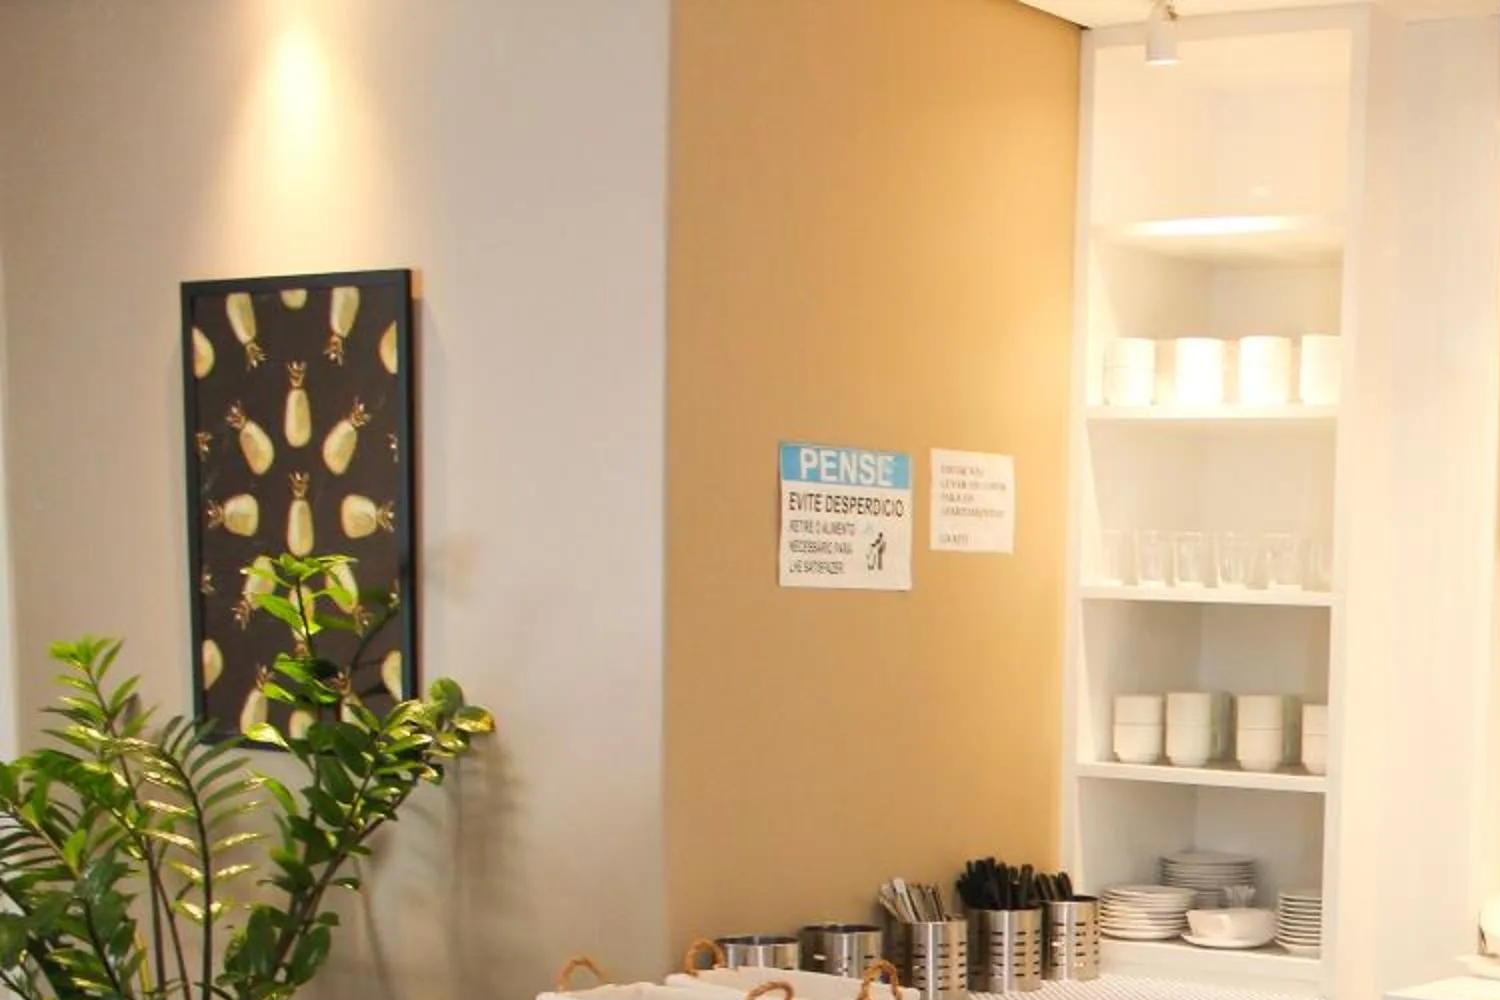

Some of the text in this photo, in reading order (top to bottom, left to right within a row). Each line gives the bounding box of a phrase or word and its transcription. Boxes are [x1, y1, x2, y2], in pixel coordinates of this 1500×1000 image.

[799, 447, 895, 487] PENSE
[788, 491, 905, 518] EVITE DESPERDICIO
